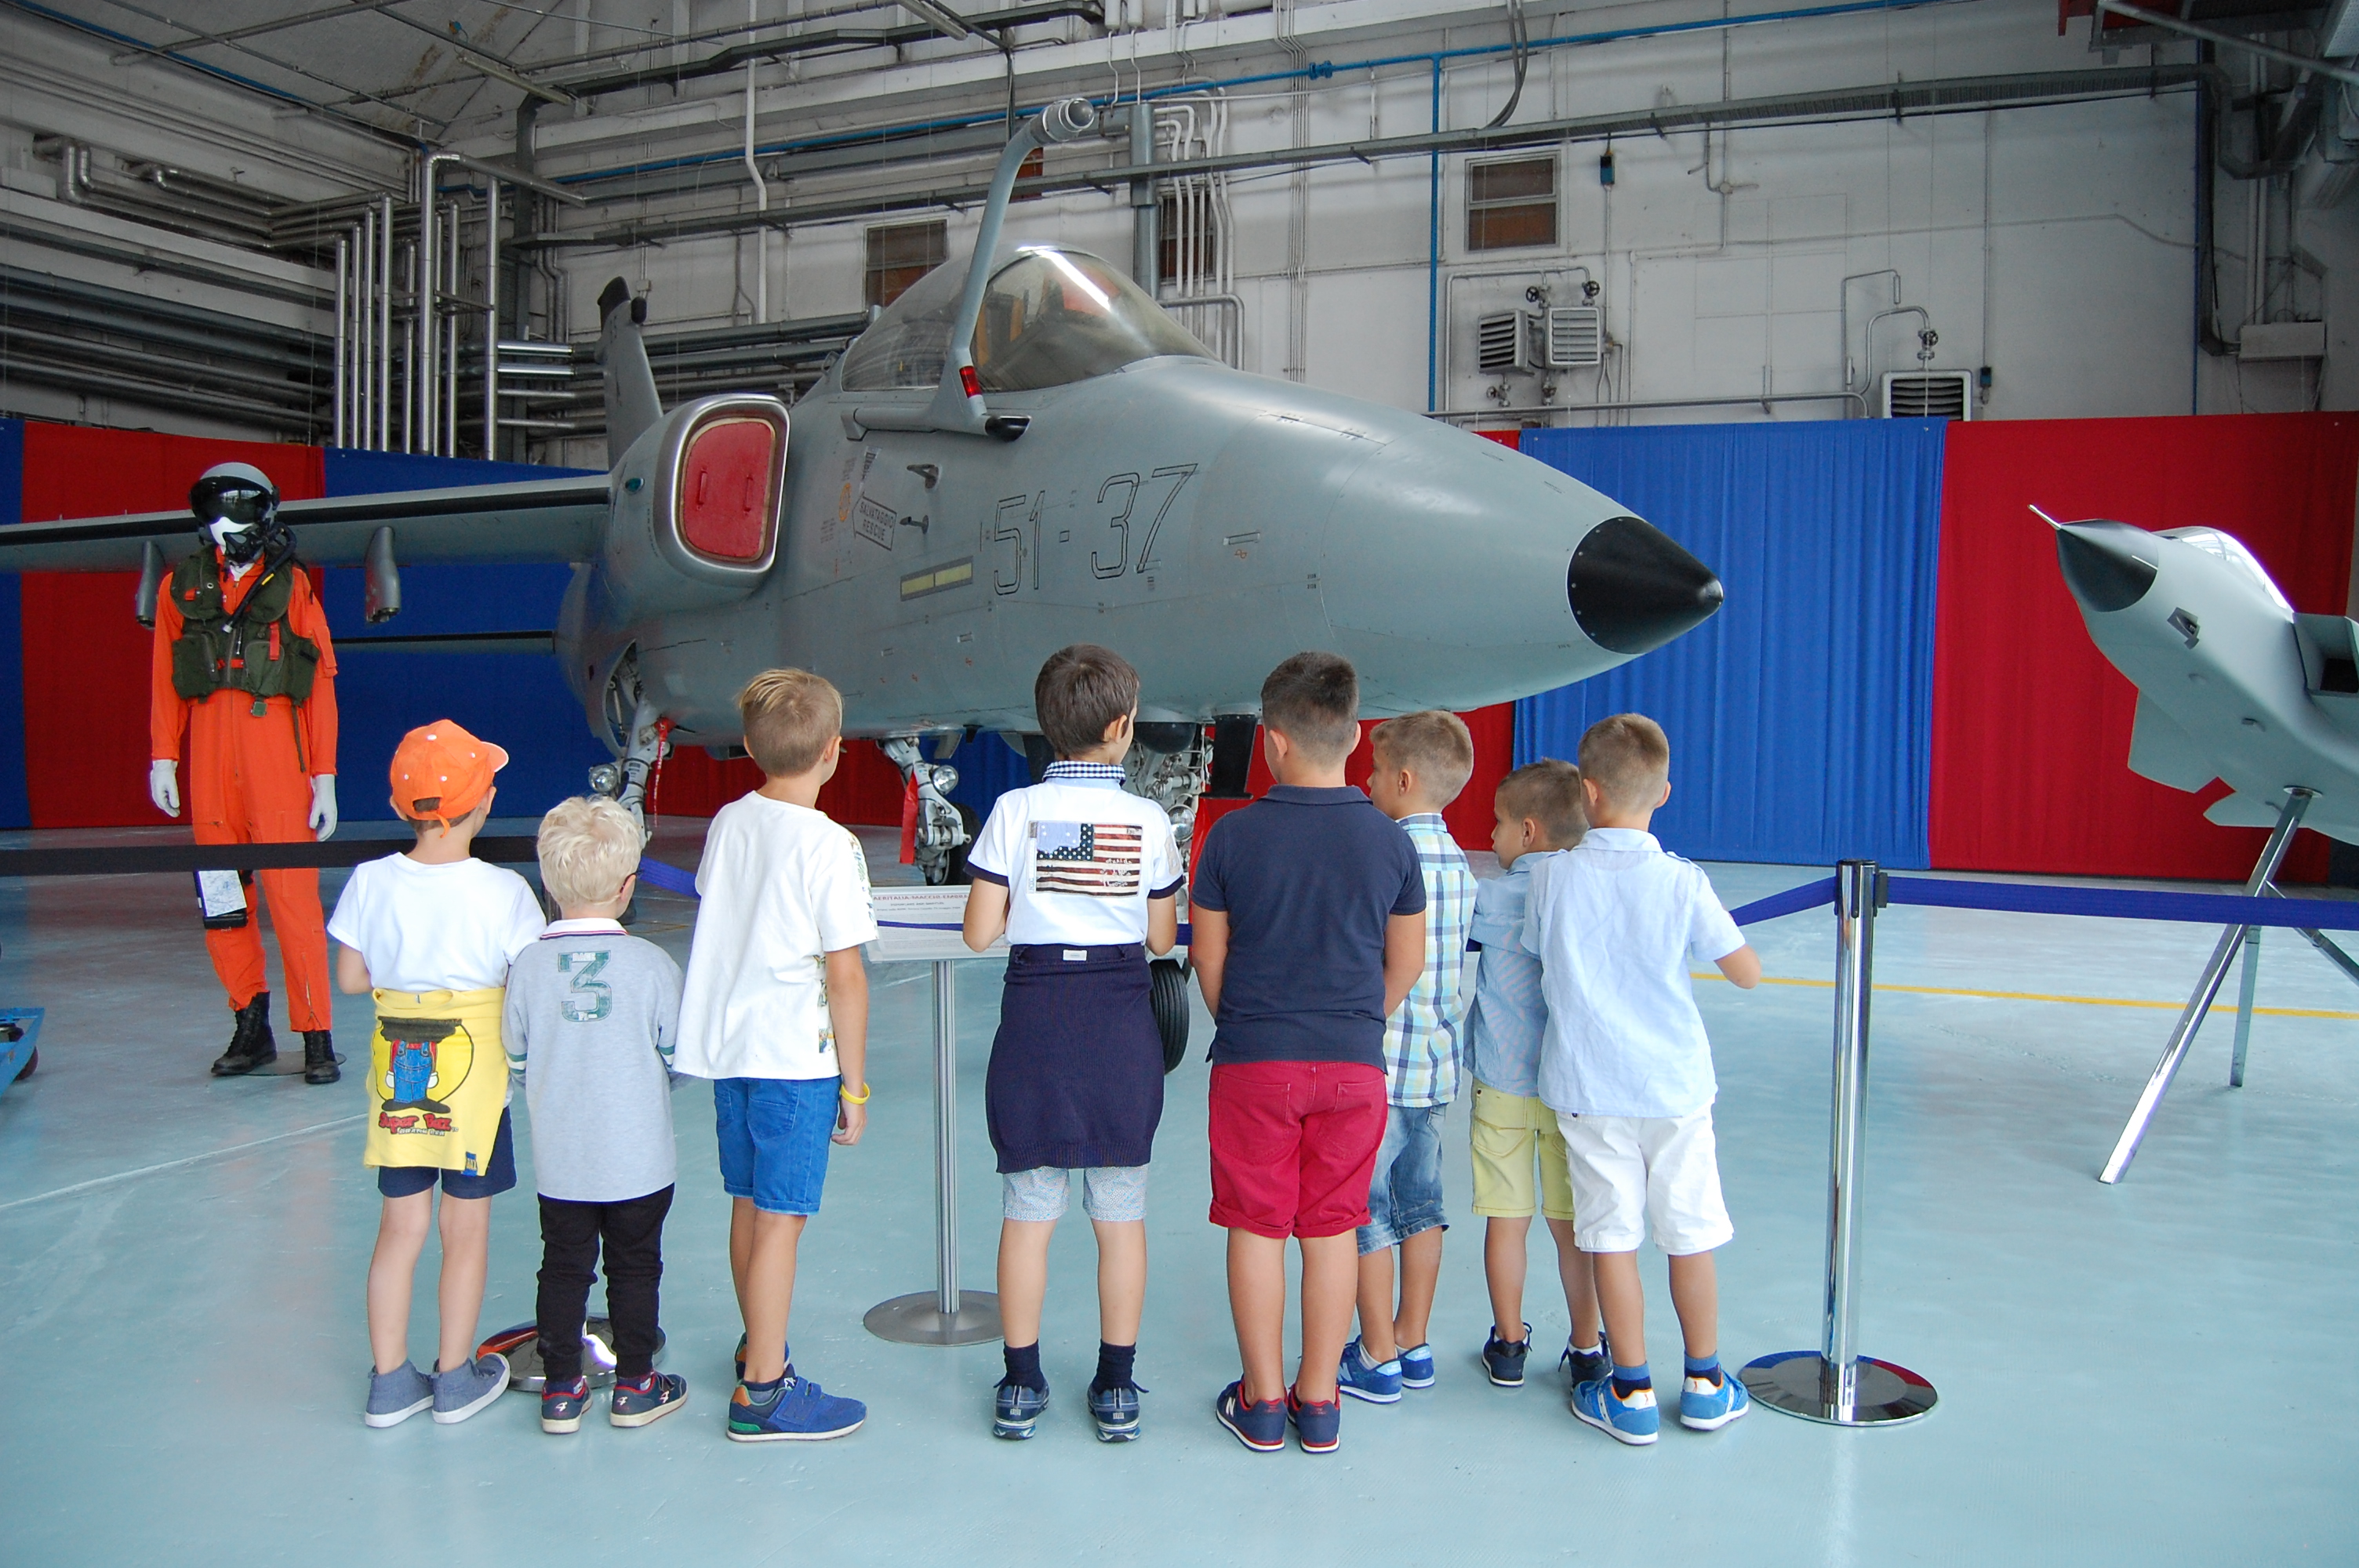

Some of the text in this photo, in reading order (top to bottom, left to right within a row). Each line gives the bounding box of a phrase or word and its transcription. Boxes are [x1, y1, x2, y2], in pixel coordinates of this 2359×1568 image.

[863, 518, 886, 541] RESCUE
[558, 949, 612, 1022] 3
[379, 1112, 420, 1134] Super
